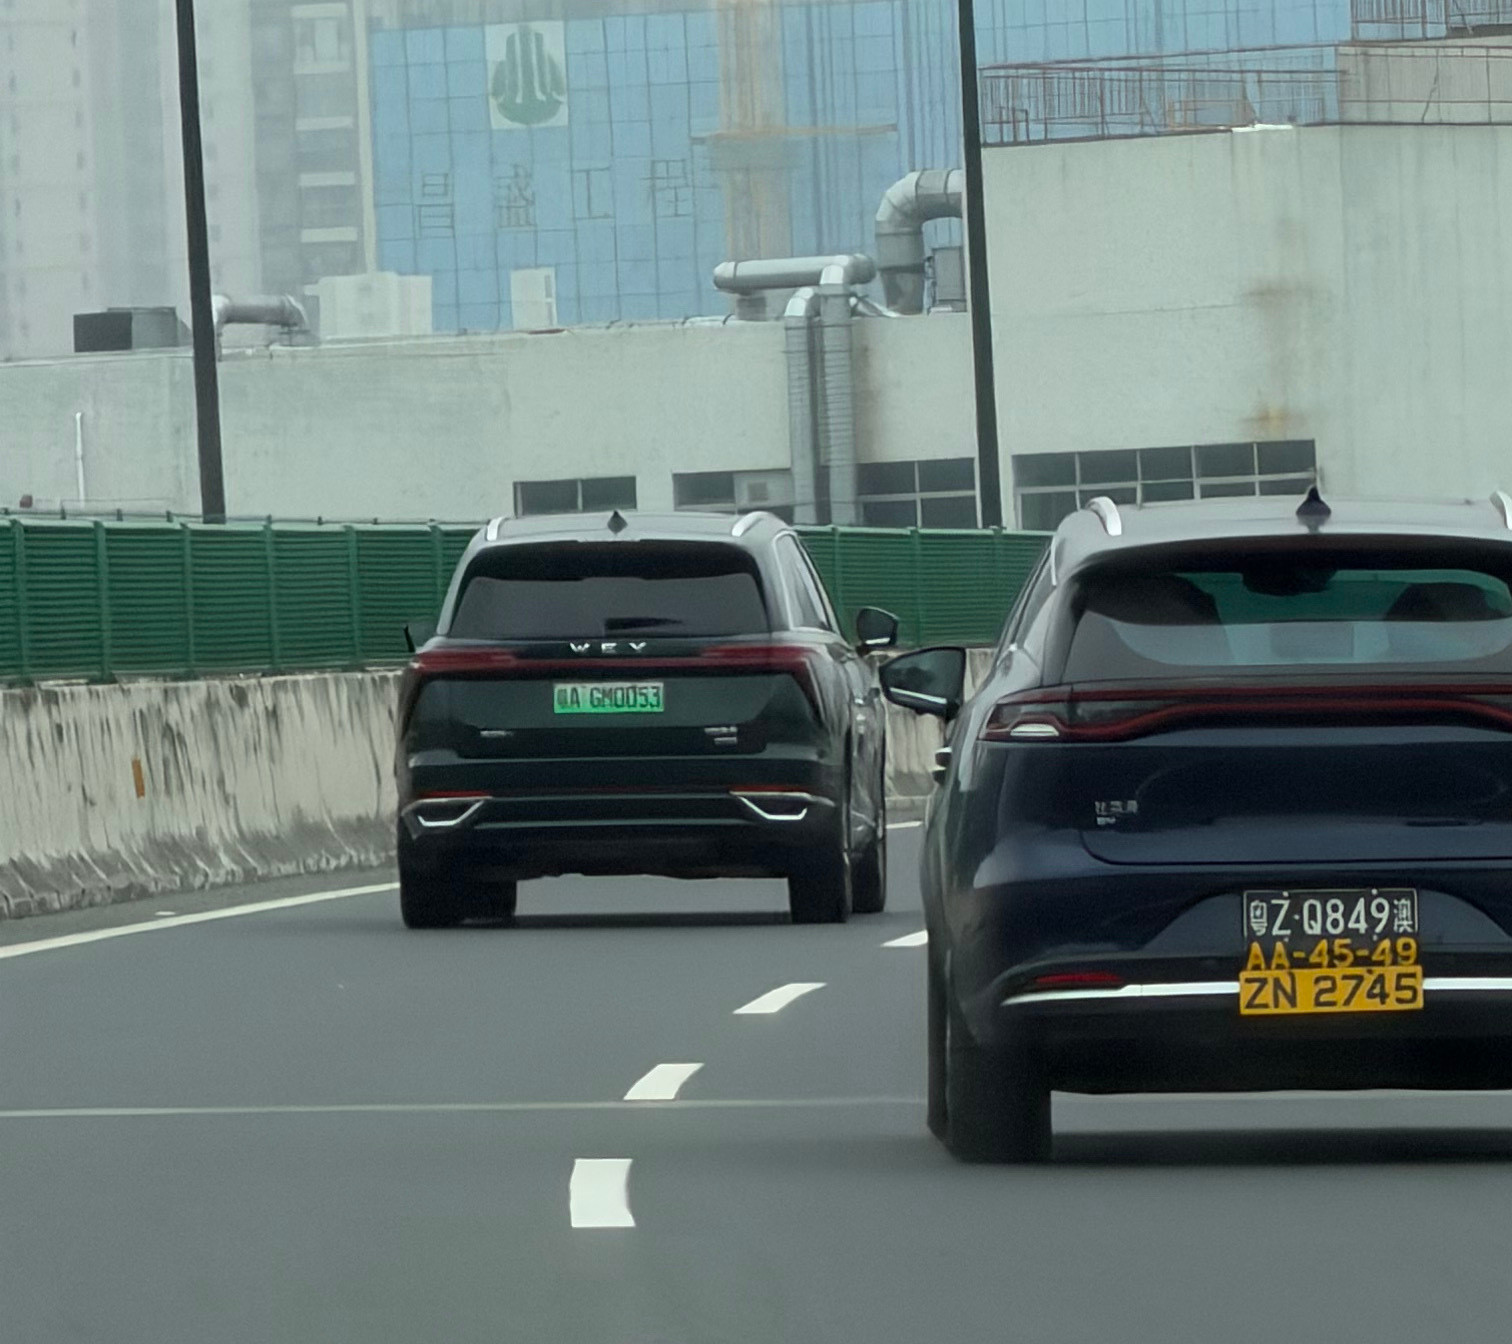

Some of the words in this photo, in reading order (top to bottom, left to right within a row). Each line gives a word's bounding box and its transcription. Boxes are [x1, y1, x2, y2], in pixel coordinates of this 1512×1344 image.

[569, 642, 647, 654] WEY
[1247, 937, 1418, 971] AA-45-49
[1244, 974, 1298, 1009] ZN
[1313, 972, 1419, 1008] 2745
